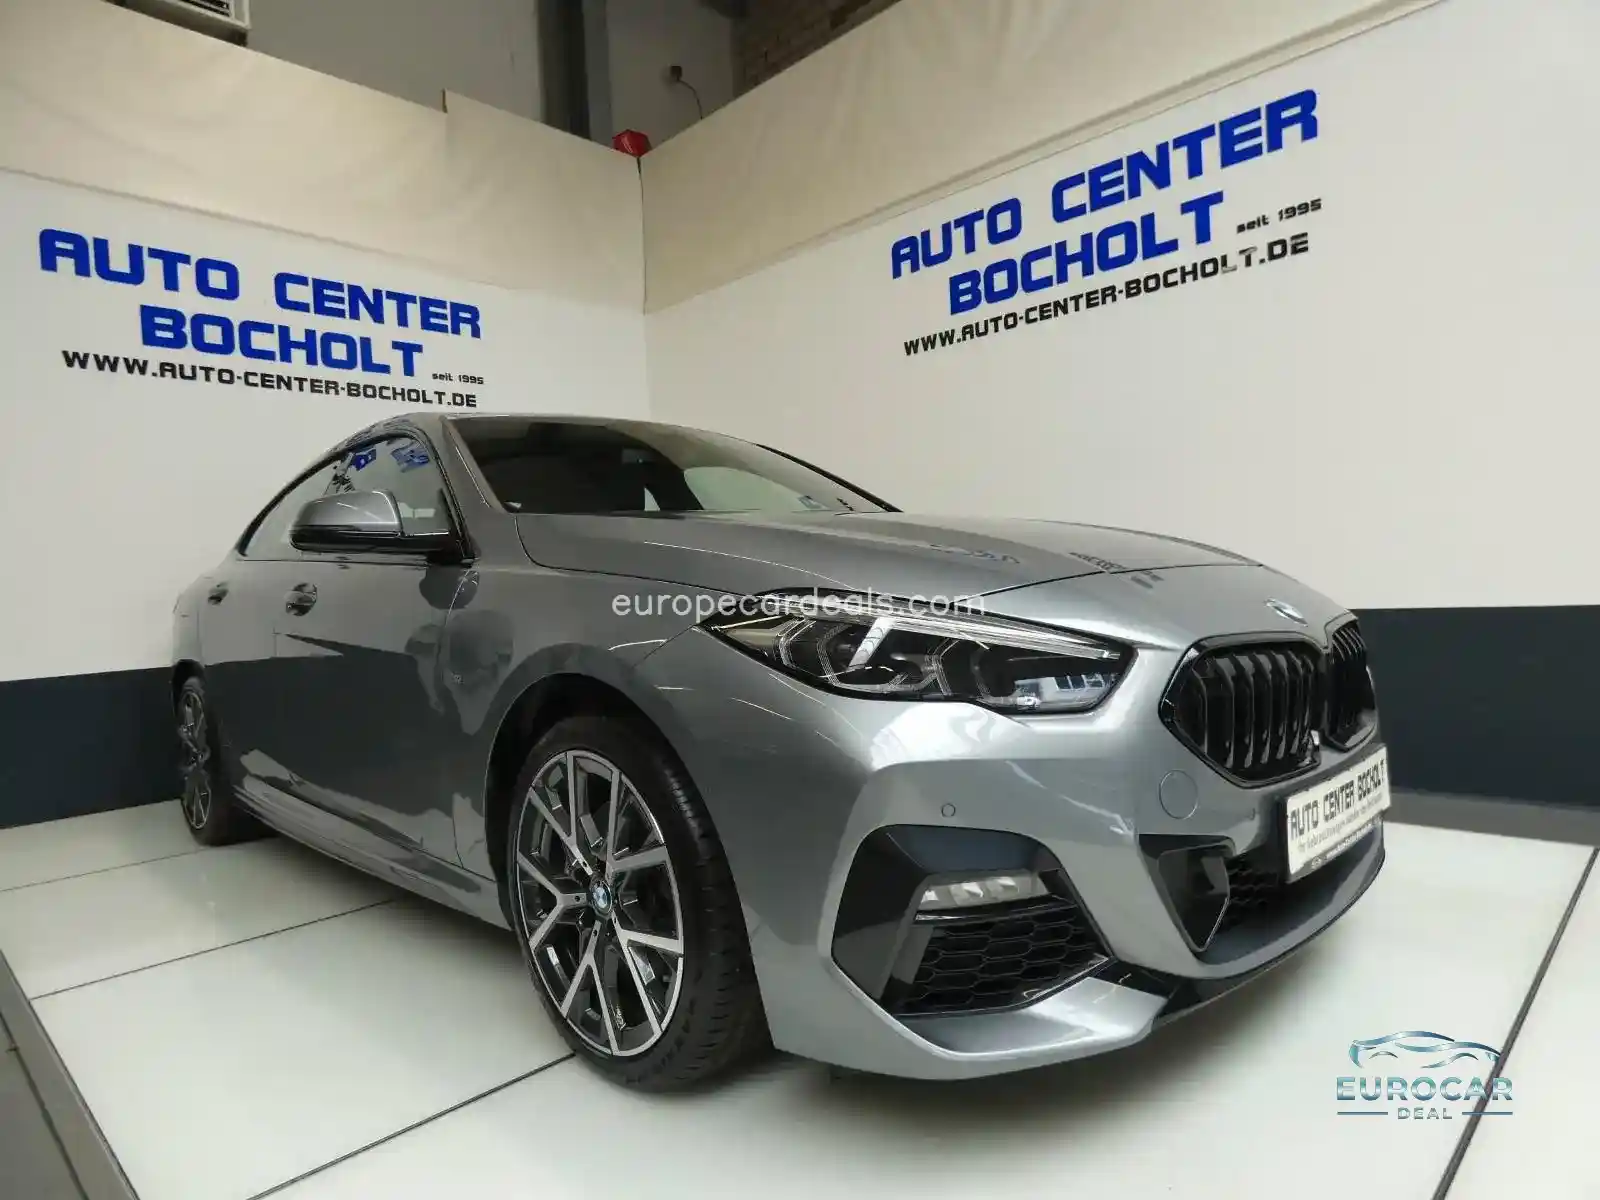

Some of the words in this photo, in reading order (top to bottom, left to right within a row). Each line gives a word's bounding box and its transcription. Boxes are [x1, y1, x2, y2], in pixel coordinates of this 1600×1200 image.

[892, 197, 1022, 279] AUTO
[1052, 89, 1318, 223] CENTER
[1236, 214, 1270, 234] seit
[1278, 198, 1322, 222] 1995
[39, 227, 239, 302] AUTO
[274, 272, 482, 339] CENTER
[949, 191, 1223, 316] BOCHOLT
[904, 232, 1309, 356] WWW.AUTO-CENTER-BOCHOLT.DE
[140, 304, 424, 377] BOCHOLT
[62, 349, 477, 408] WWW.AUTO-CENTER-BOCHOLT.DE
[432, 372, 454, 382] seit
[458, 375, 484, 385] 1995
[1289, 799, 1319, 840] AUTO
[1322, 779, 1355, 822] CENTER
